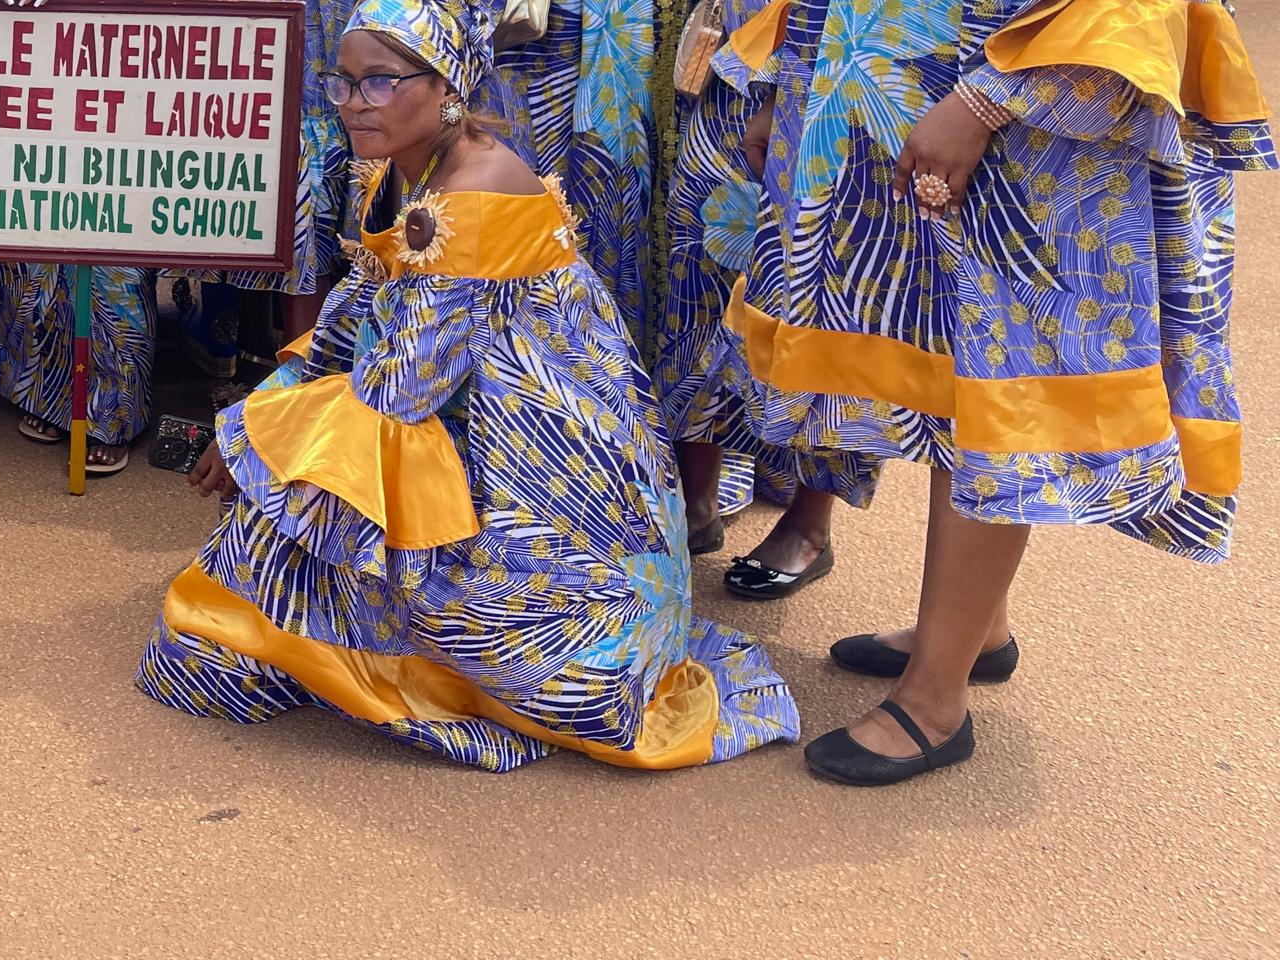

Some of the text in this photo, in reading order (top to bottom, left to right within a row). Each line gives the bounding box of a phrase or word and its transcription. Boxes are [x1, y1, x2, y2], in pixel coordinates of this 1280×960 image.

[53, 22, 276, 81] MATERNELLE
[75, 89, 125, 133] ET
[145, 92, 272, 140] LAIQUE
[13, 144, 67, 184] NJI
[83, 147, 267, 192] BILINGUAL
[151, 196, 263, 240] SCHOOL
